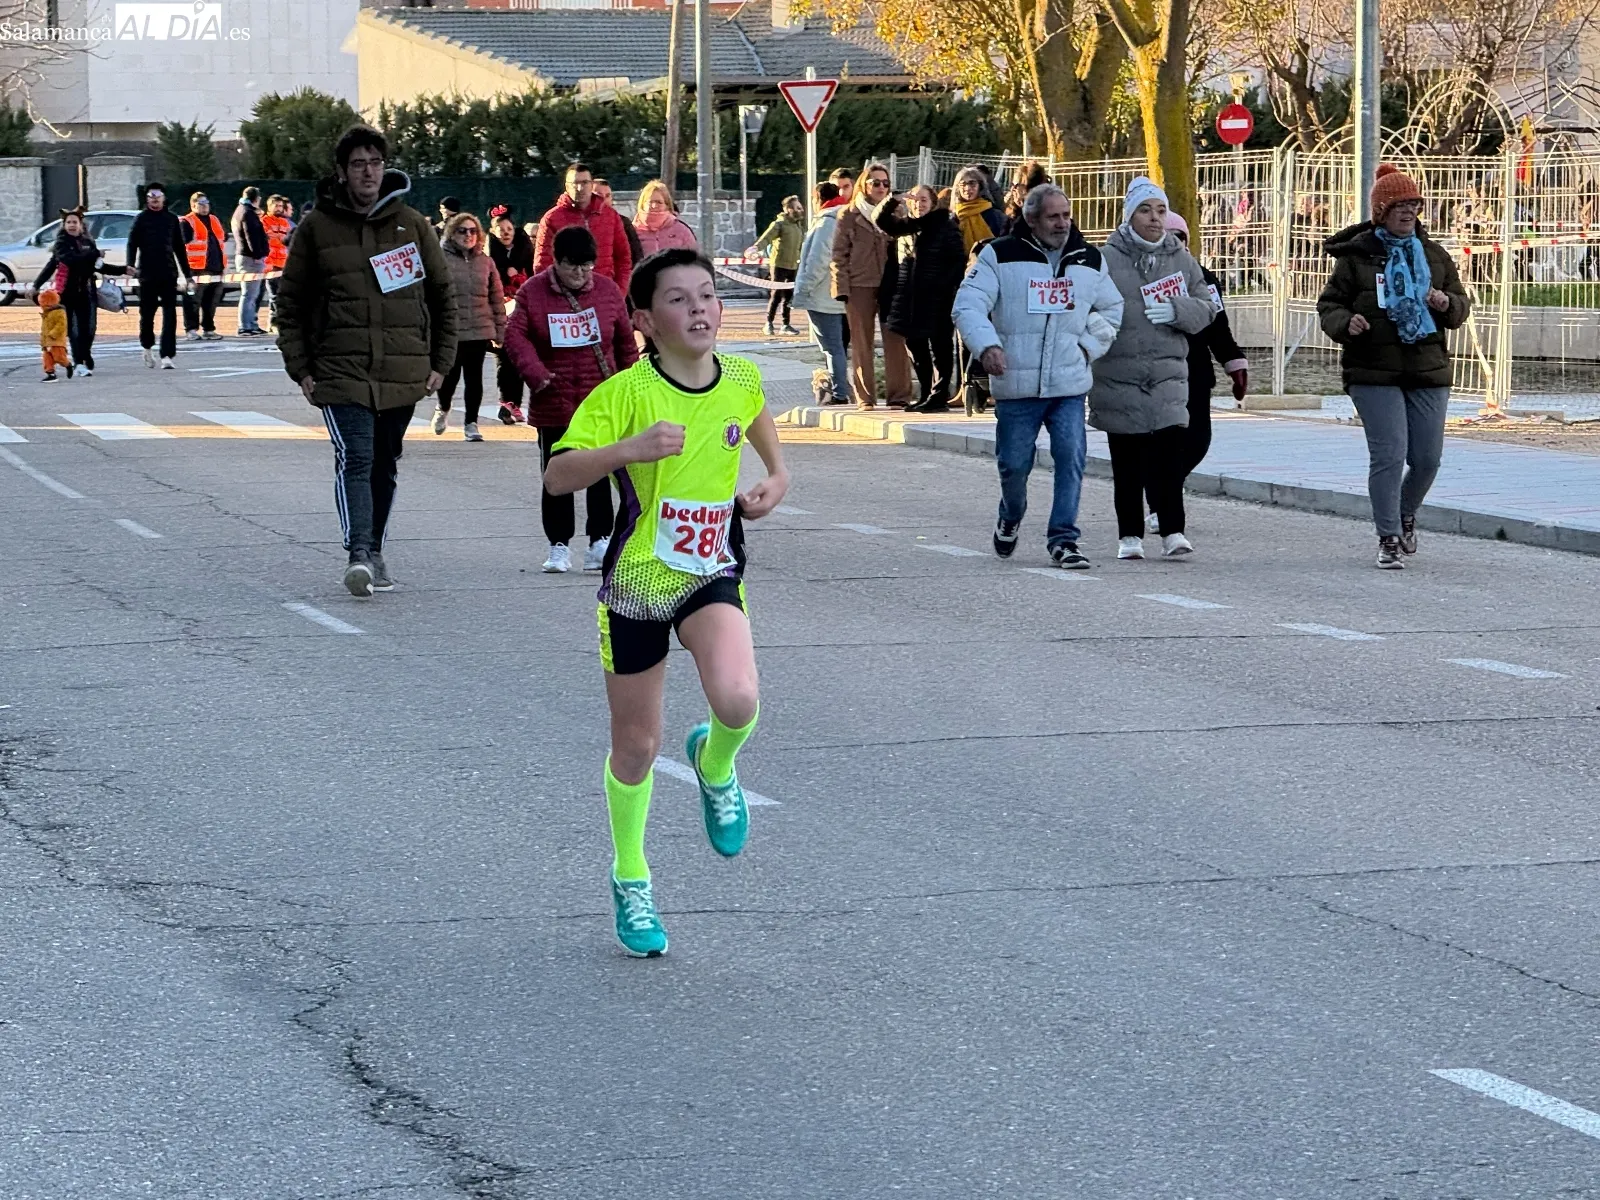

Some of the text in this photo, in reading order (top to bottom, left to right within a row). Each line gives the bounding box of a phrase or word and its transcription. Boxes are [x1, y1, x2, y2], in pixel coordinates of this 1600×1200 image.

[384, 258, 413, 280] 139
[1029, 279, 1073, 289] bedunia
[1037, 288, 1069, 305] 163
[549, 311, 595, 324] bedunia
[559, 322, 592, 339] 103
[673, 523, 726, 559] 280
